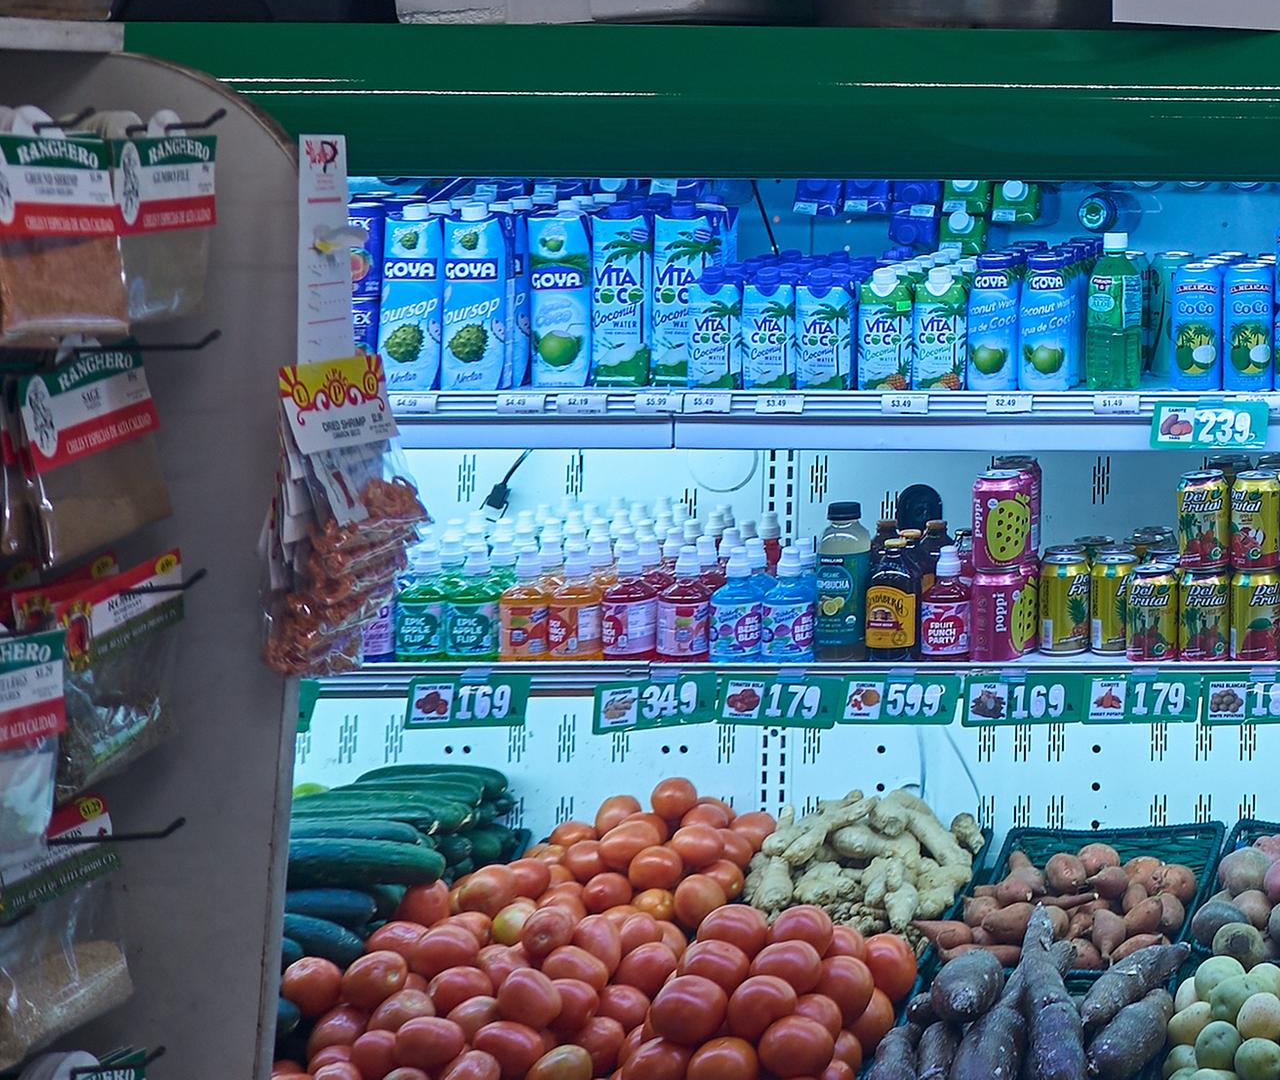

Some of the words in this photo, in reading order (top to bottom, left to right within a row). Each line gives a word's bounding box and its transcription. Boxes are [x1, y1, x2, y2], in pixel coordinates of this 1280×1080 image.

[385, 261, 435, 277] GOYA
[445, 261, 496, 277] GOYA
[594, 264, 637, 286] VITA
[532, 272, 583, 289] GOYA
[974, 275, 1008, 289] GOYA
[1032, 275, 1064, 289] GOYA
[593, 287, 645, 305] COCO
[654, 287, 689, 305] COC
[594, 303, 637, 329] Coconut
[612, 321, 637, 329] WATER
[694, 317, 726, 332] VITA
[753, 317, 782, 332] VITA
[803, 318, 834, 334] VITA
[865, 317, 897, 332] VITA
[920, 317, 950, 332] VITA
[692, 332, 731, 345] COCO
[751, 332, 787, 345] COCO
[801, 333, 840, 346] COCO
[863, 332, 901, 345] COCO
[918, 332, 956, 345] COCO
[568, 397, 589, 406] $2.19
[646, 397, 667, 406] $5.99
[766, 399, 787, 408] $3.49
[890, 399, 912, 408] $3.49
[995, 398, 1016, 407] $2.49
[1102, 399, 1123, 407] $1.49
[1198, 411, 1251, 443] 239
[1183, 490, 1207, 503] Del
[1181, 499, 1222, 512] Frutal
[973, 498, 982, 538] poppi
[1131, 583, 1154, 596] Del
[1189, 583, 1214, 596] Del
[1254, 583, 1279, 596] Del
[1128, 593, 1169, 607] Frutal
[1186, 593, 1227, 607] Frutal
[994, 592, 1008, 633] poppi
[404, 617, 425, 626] EPIC
[456, 617, 477, 626] EPIC
[930, 622, 954, 630] FRUIT
[401, 626, 431, 635] APPLE
[453, 626, 483, 635] APPLE
[928, 629, 956, 637] PUNCH
[404, 634, 424, 644] FLIP
[456, 634, 476, 644] FLIP
[928, 636, 955, 644] PARTY
[455, 684, 511, 719] 169
[642, 681, 697, 719] 349
[765, 683, 821, 719] 179
[887, 684, 942, 717] 599
[1012, 684, 1065, 719] 169
[1132, 682, 1185, 715] 179
